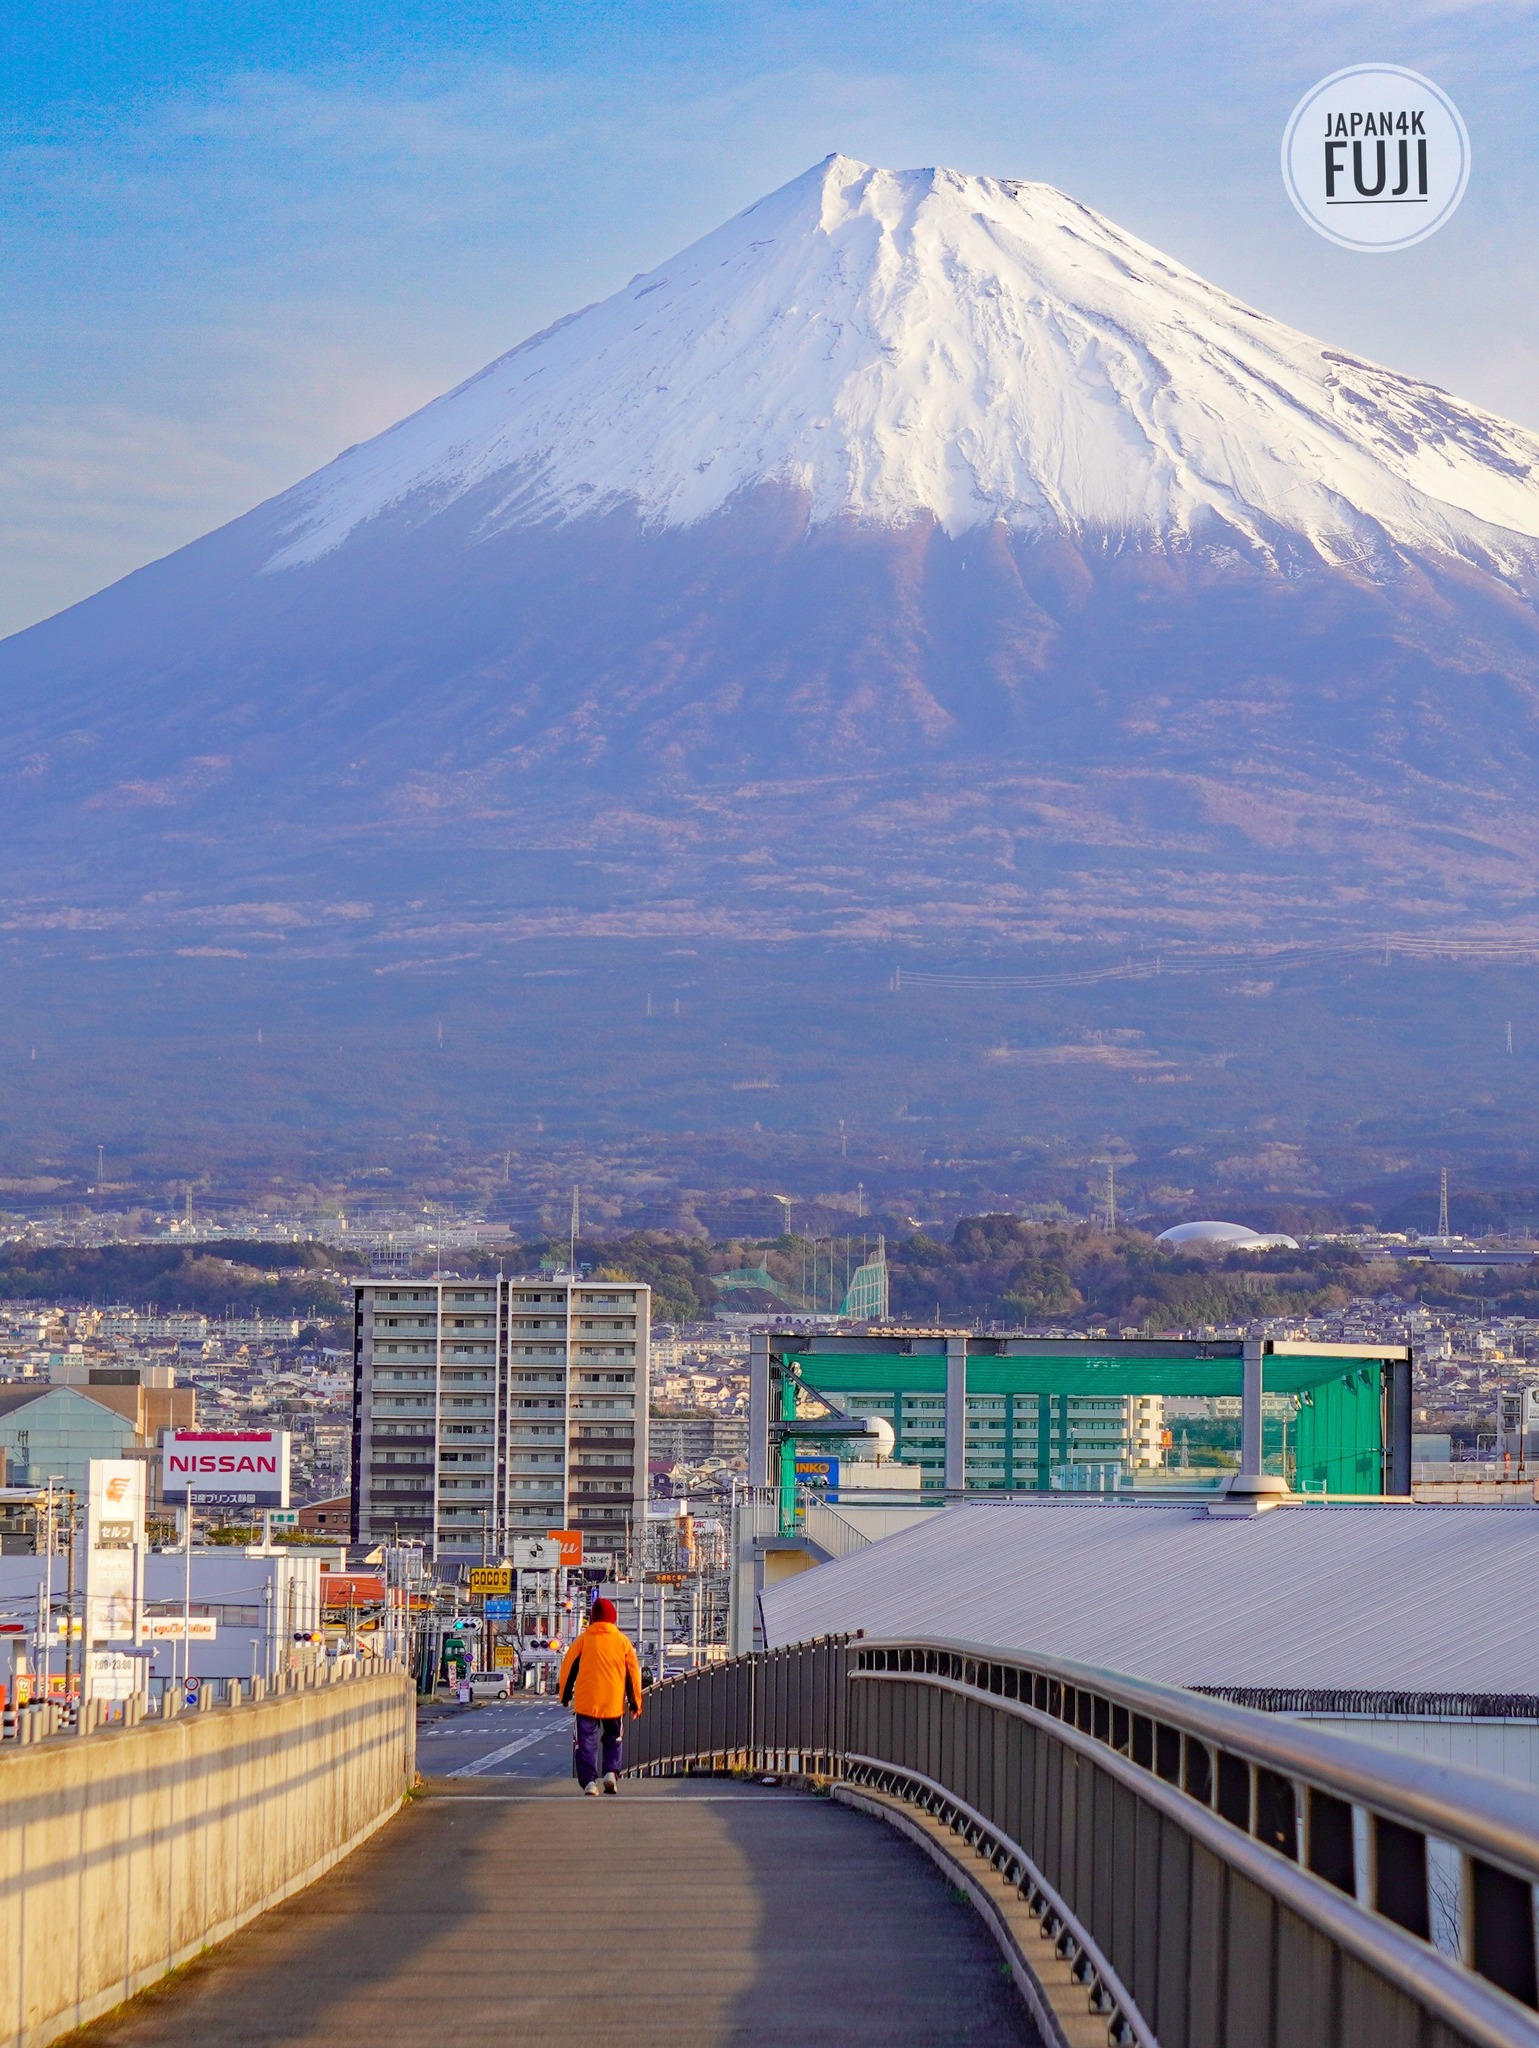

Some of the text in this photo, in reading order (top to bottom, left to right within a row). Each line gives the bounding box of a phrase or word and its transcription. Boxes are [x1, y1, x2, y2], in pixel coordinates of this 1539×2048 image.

[169, 1455, 276, 1473] NISSAN
[190, 1493, 256, 1504] 日産プリンス静岡
[101, 1525, 132, 1538] セルフ
[473, 1570, 508, 1586] COCO'S
